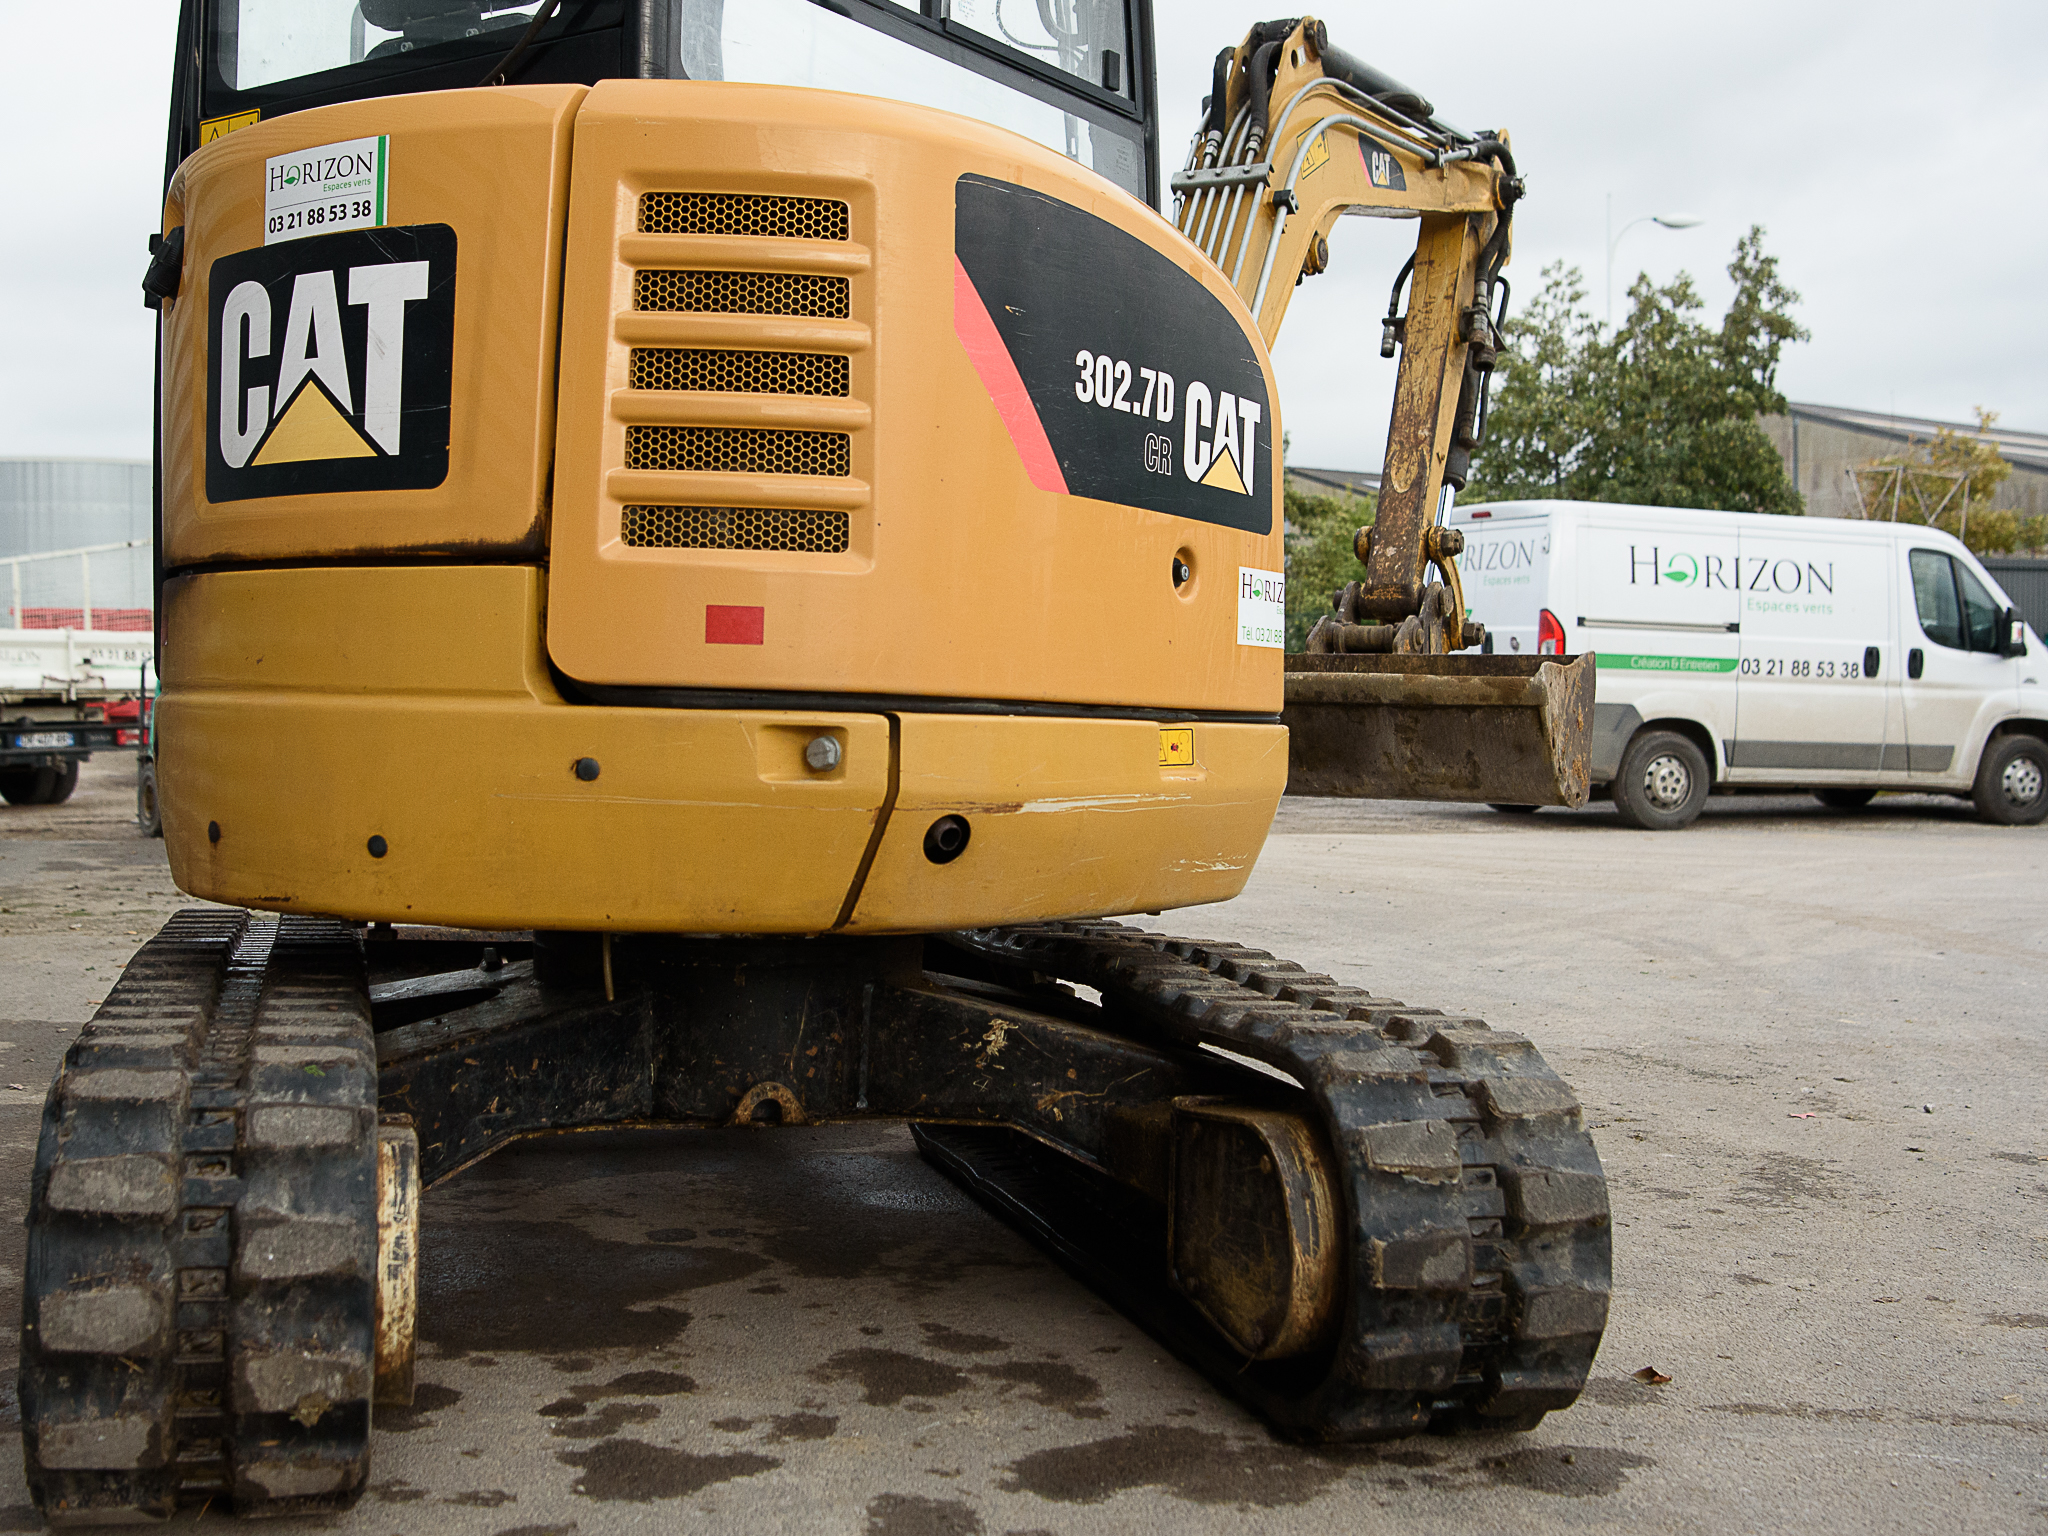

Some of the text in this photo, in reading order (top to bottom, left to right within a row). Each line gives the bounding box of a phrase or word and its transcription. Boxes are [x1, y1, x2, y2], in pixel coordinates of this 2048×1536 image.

[270, 152, 373, 192] HORIZON
[323, 178, 371, 192] Espaces verts
[1372, 151, 1390, 186] CAT
[269, 200, 371, 234] 03 21 88 53 38
[220, 260, 429, 469] CAT
[1075, 350, 1175, 423] 302.7D
[1145, 433, 1172, 475] CR
[1184, 381, 1261, 496] CAT
[1629, 546, 1833, 595] HORIZON
[1747, 598, 1833, 615] Espaces verts
[1256, 627, 1265, 641] 03
[1266, 628, 1273, 642] 21
[1274, 629, 1282, 643] 88
[1741, 658, 1859, 679] 03 21 88 53 38
